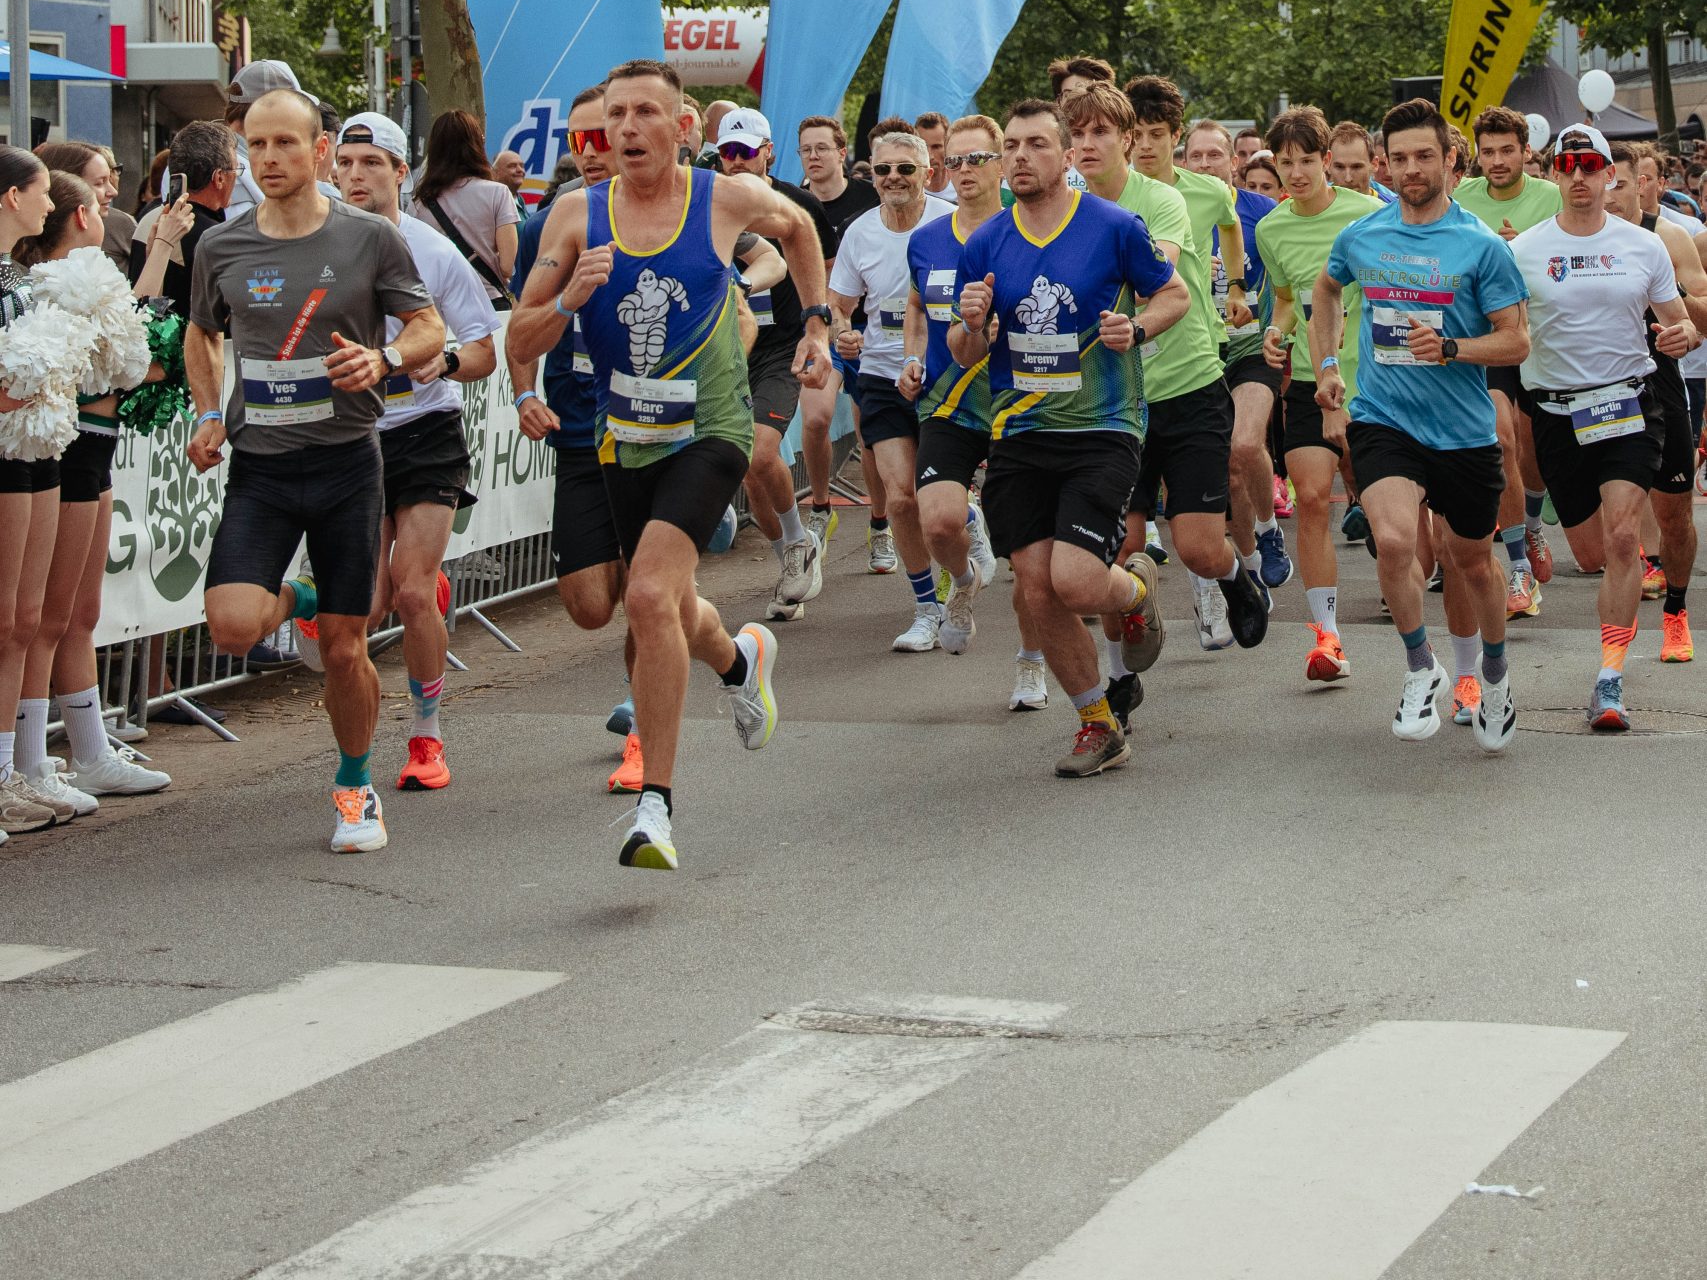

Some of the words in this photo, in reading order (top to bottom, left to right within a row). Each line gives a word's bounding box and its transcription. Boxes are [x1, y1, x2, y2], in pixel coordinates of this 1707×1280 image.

[664, 19, 740, 51] EGEL
[1388, 290, 1420, 300] AKTIV
[1022, 352, 1059, 367] Jeremy
[267, 381, 298, 394] Yves
[275, 396, 293, 404] 4430
[631, 398, 664, 414] Marc
[1590, 401, 1622, 417] Martin
[637, 414, 656, 423] 3253
[1601, 413, 1616, 422] 2222
[491, 428, 557, 491] HOM
[1078, 525, 1105, 543] hummel
